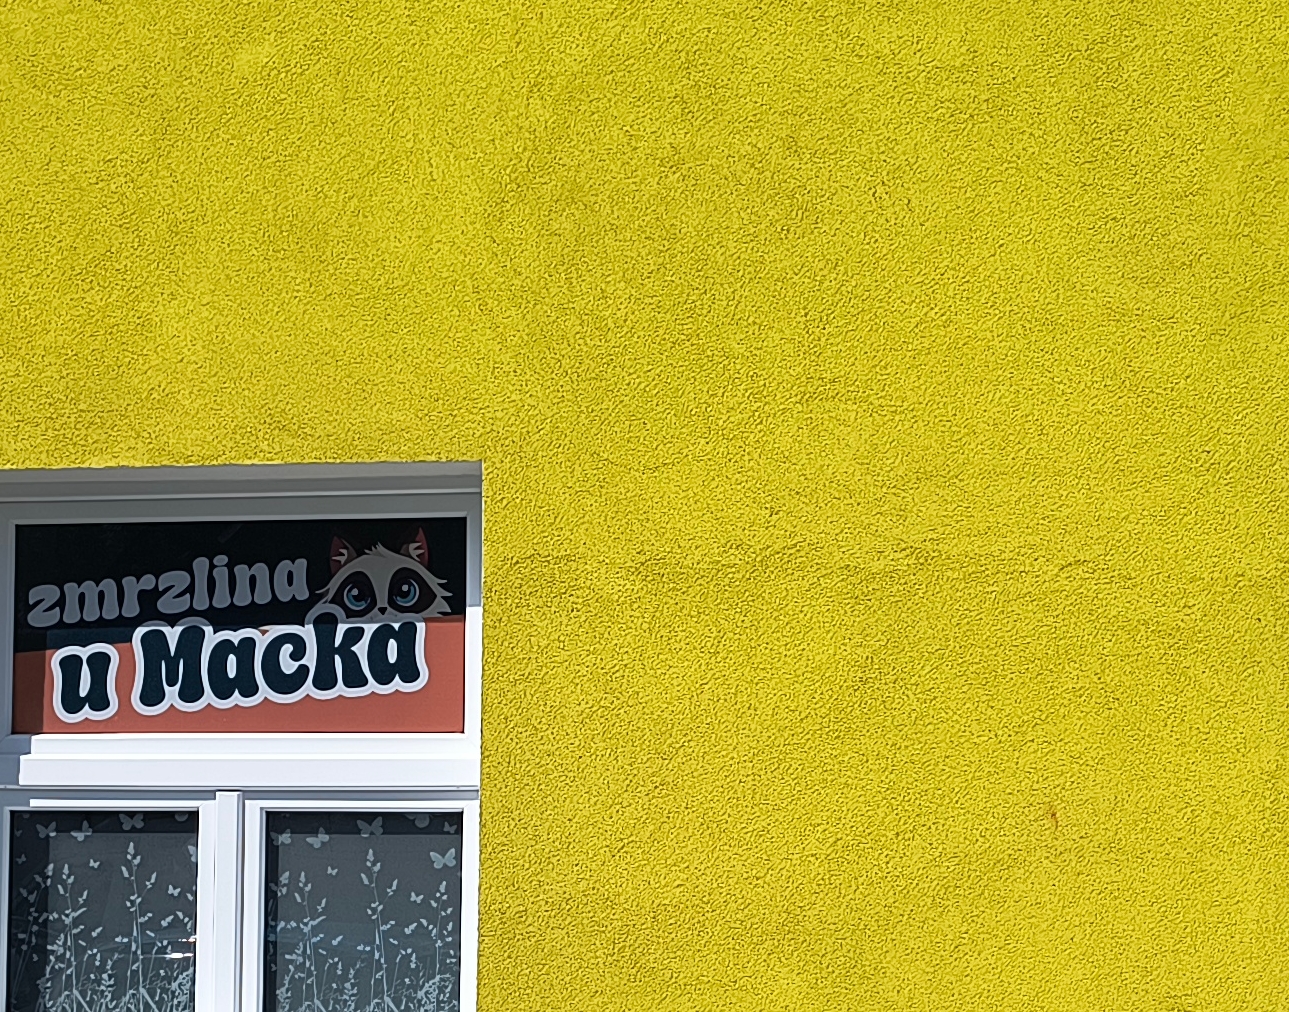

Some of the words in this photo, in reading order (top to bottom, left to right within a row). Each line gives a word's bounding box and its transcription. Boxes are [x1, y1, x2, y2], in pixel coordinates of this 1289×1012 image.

[27, 554, 309, 628] zmrzlina
[52, 643, 119, 722] u
[132, 604, 427, 716] Macka
